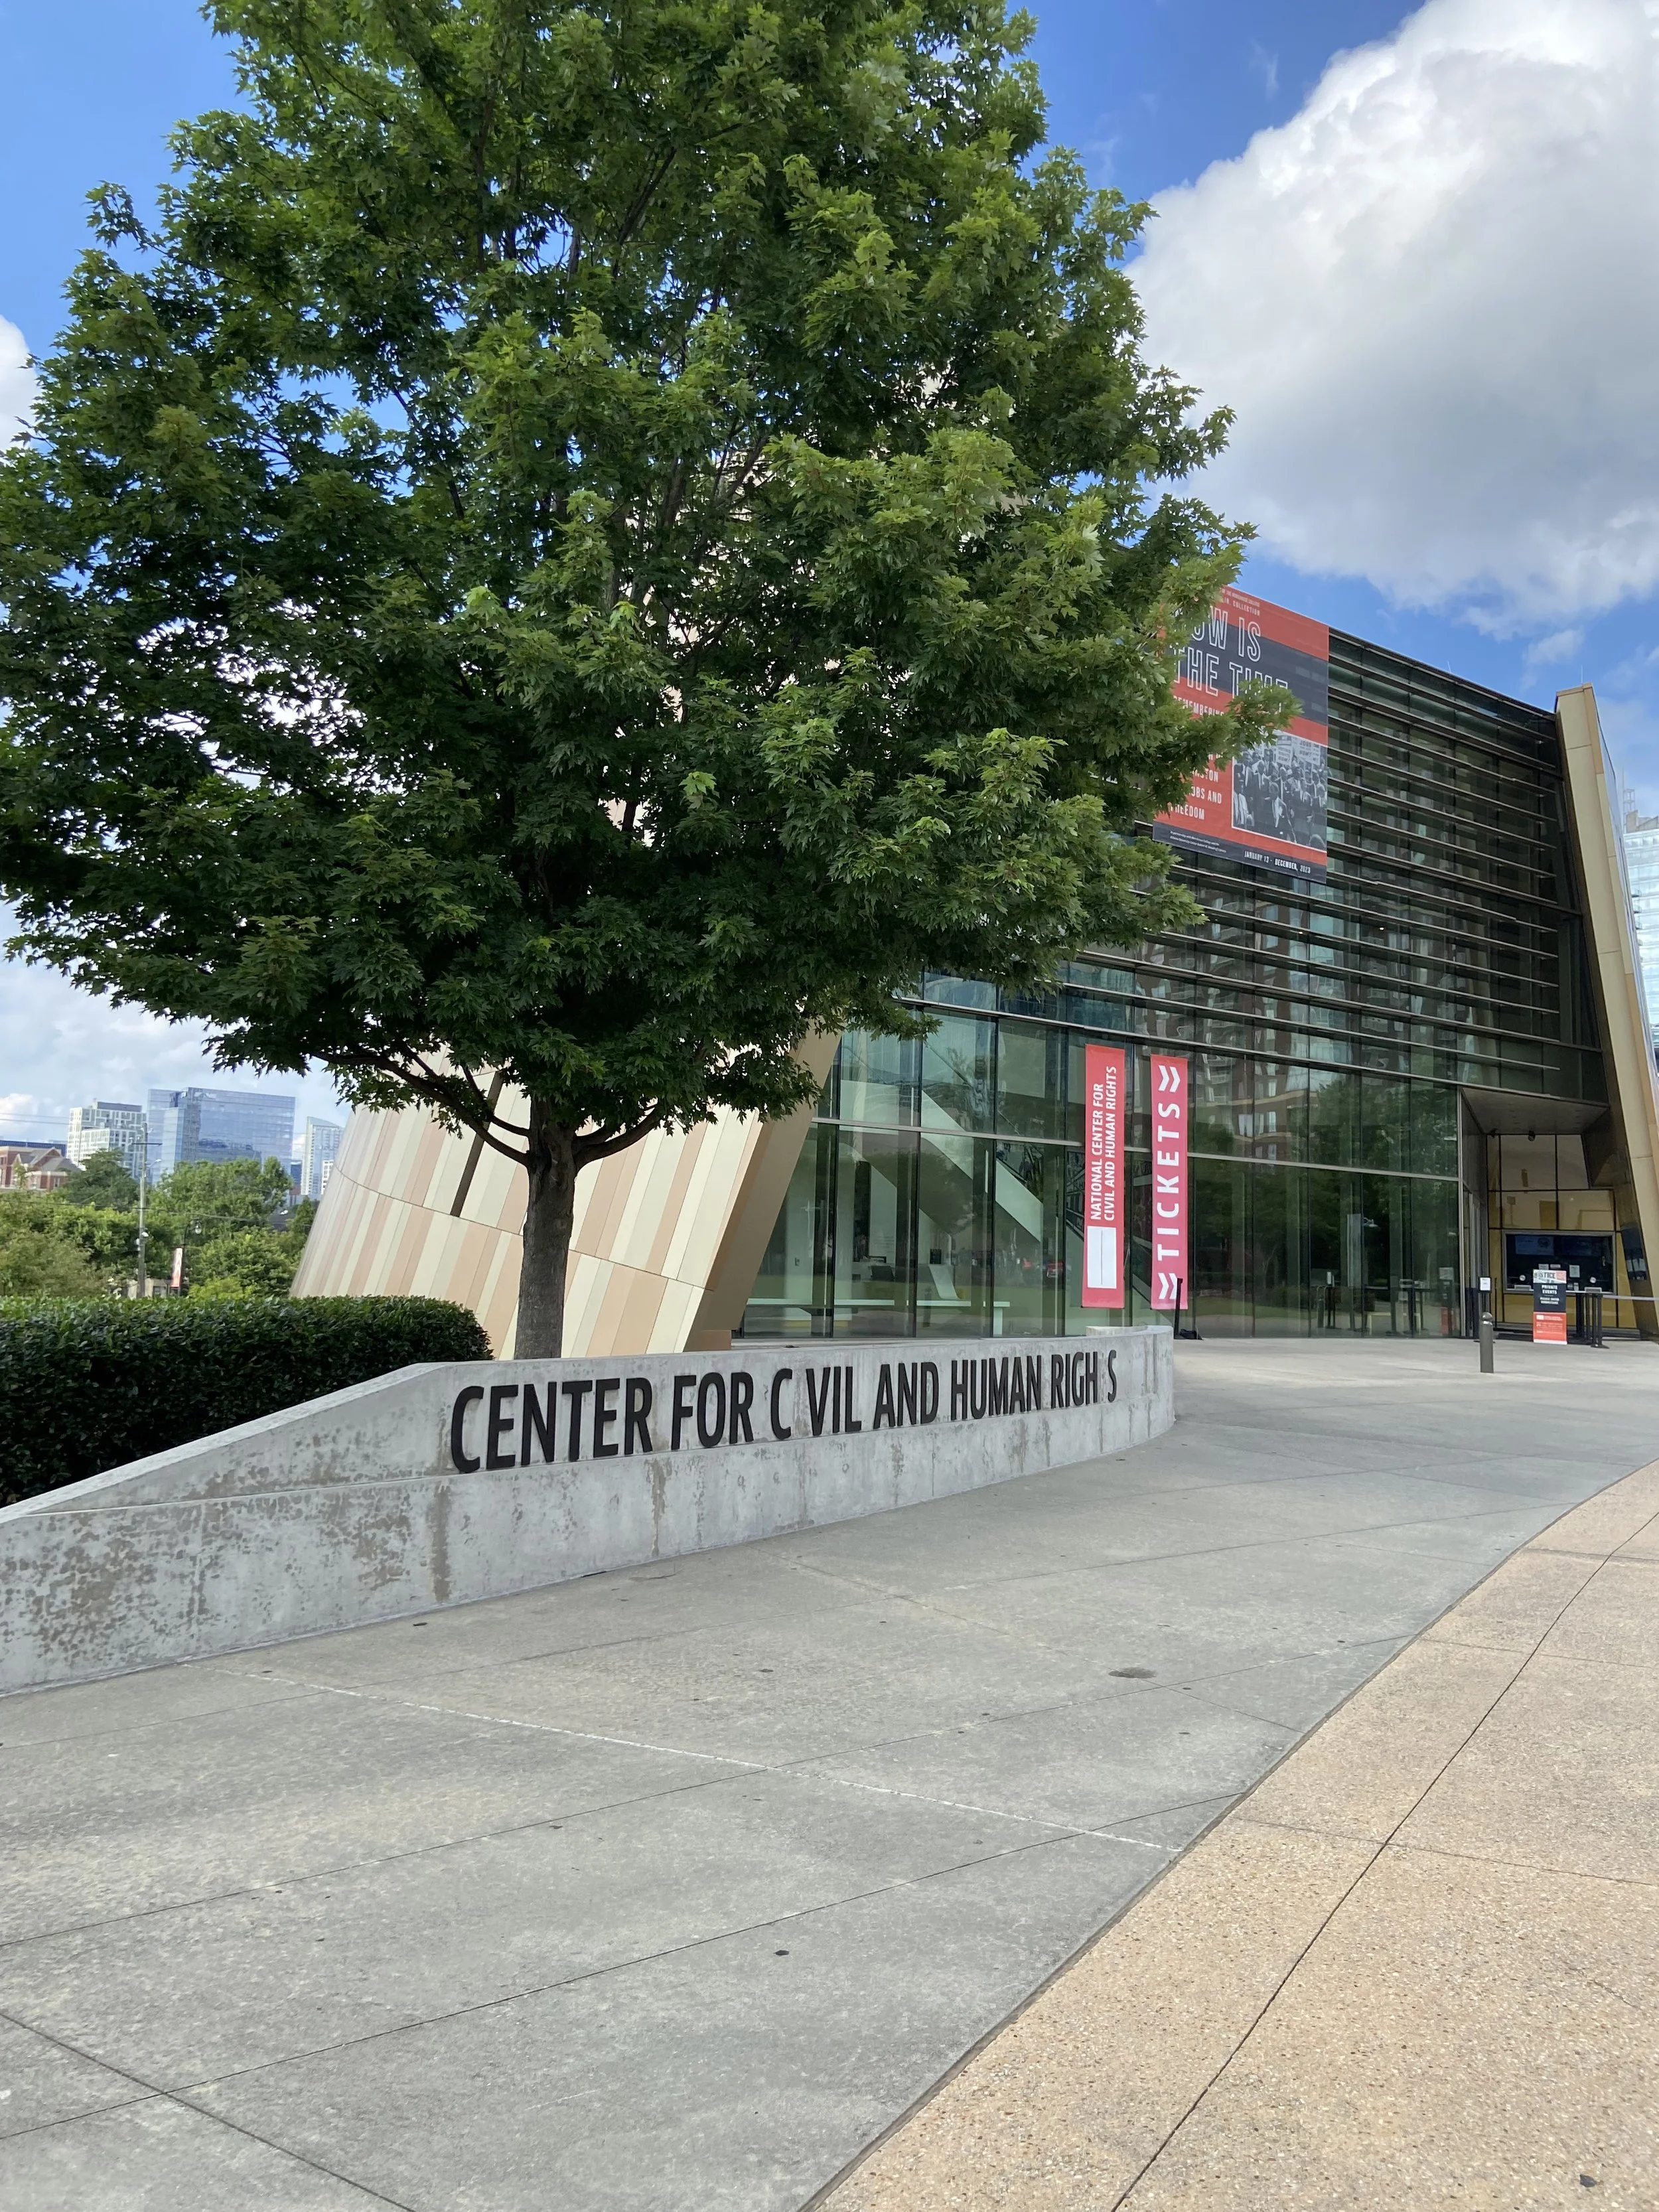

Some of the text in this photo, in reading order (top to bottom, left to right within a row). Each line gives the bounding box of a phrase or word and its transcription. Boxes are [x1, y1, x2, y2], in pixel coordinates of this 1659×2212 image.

[1238, 617, 1262, 662] IS
[1229, 662, 1288, 713] TI
[1170, 803, 1204, 820] REEDOM
[1189, 786, 1222, 804] OBS AND
[1244, 850, 1262, 861] JANUARY
[1299, 865, 1311, 874] 2023
[1090, 1083, 1104, 1220] NATIONAL CENTER FOR
[1104, 1066, 1117, 1221] CIVIL AND HUMAN RIGHTS
[1157, 1102, 1180, 1261] TICKETS
[451, 1349, 1117, 1473] CENTER FOR CVIL AND HUMAN RIGHS
